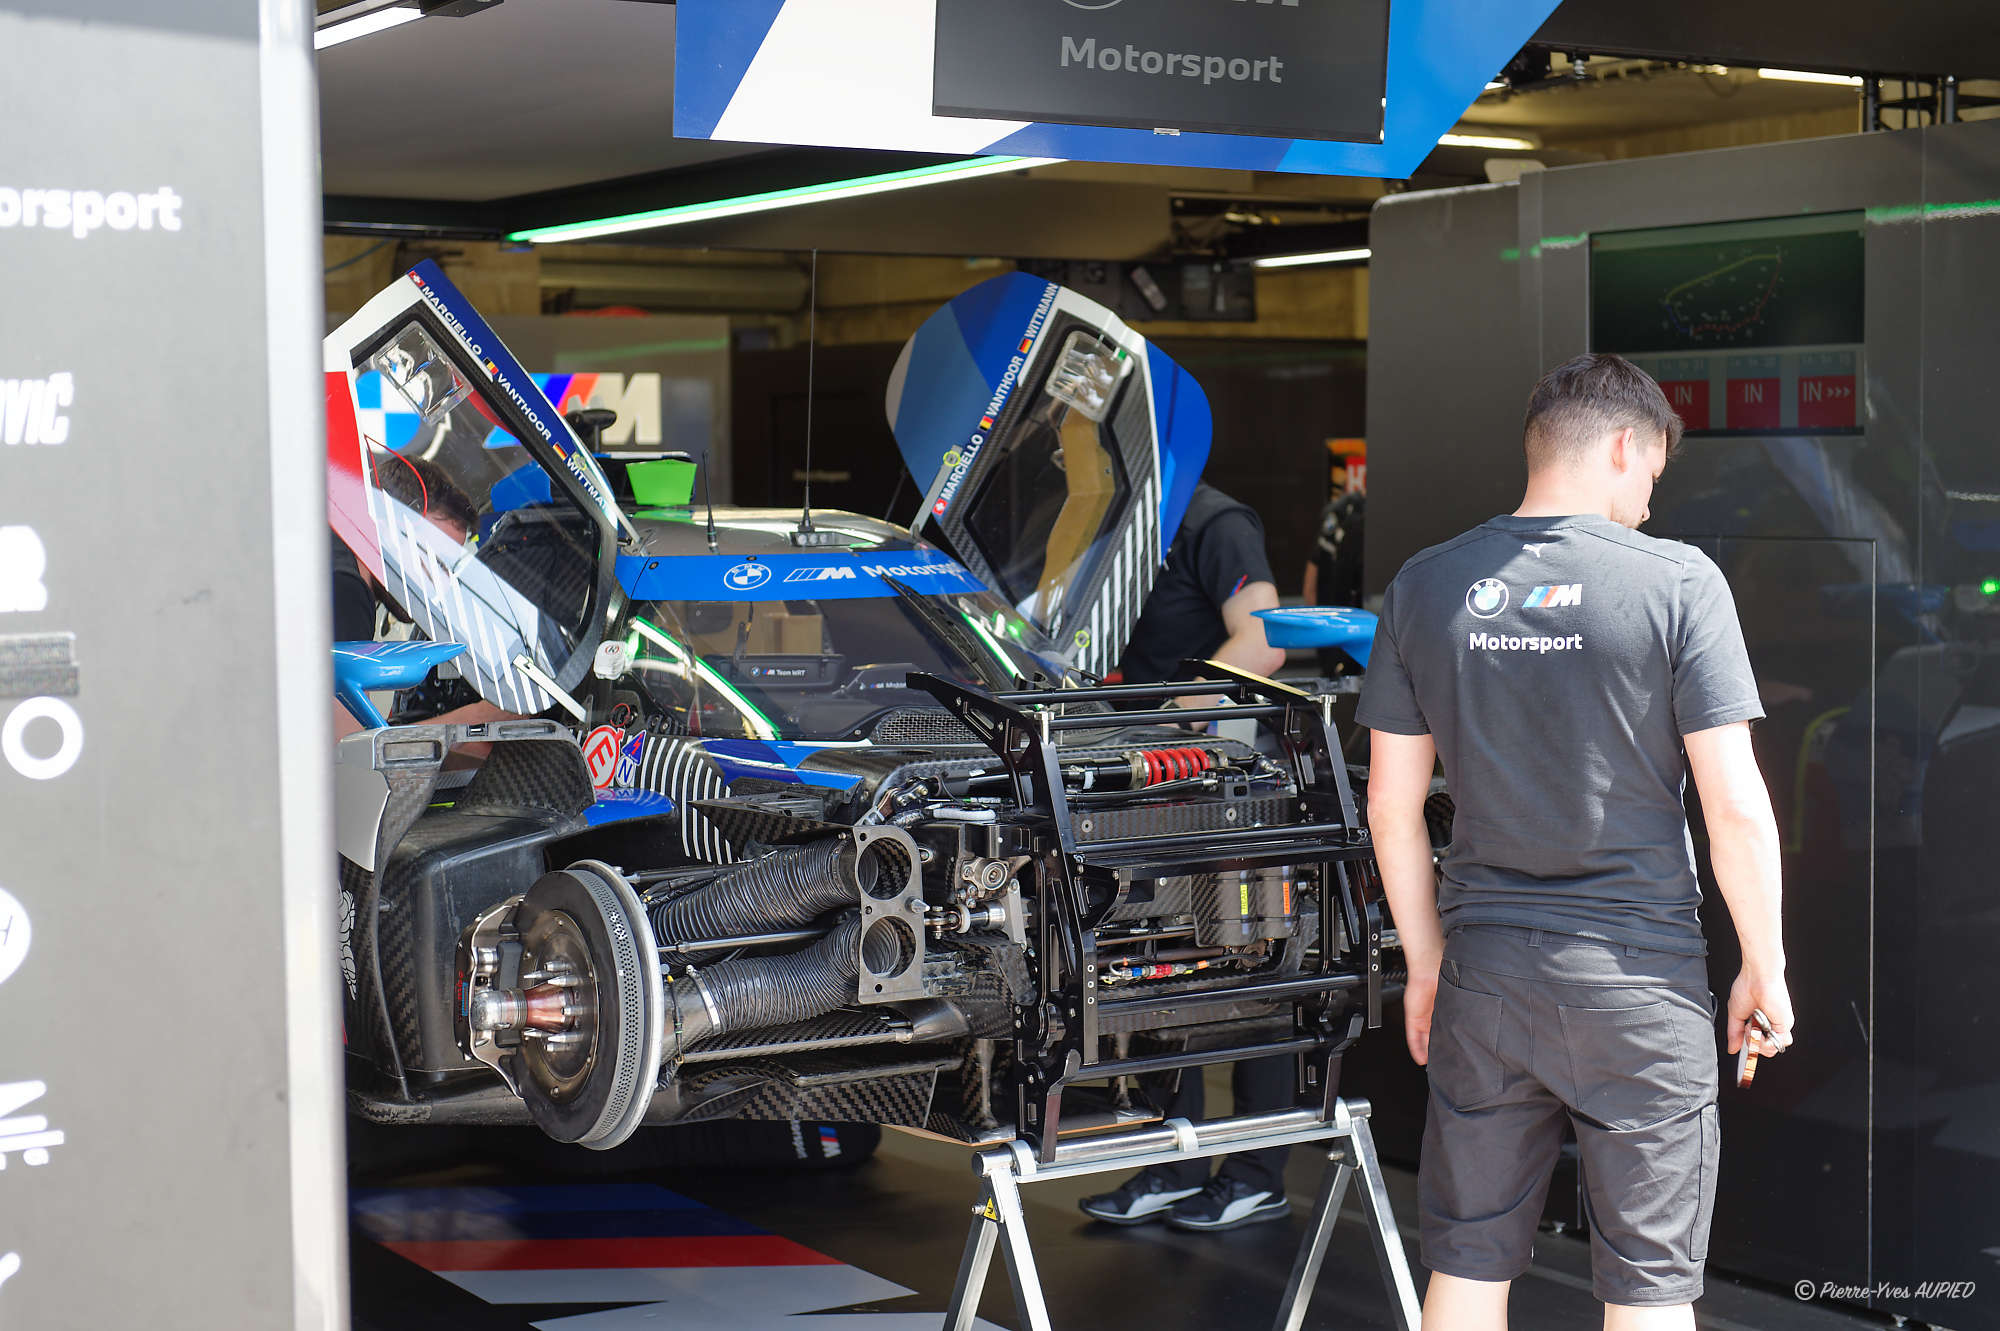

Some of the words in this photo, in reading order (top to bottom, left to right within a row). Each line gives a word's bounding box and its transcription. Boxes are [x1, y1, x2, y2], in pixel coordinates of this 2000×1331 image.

[1060, 36, 1284, 85] Motorsport
[422, 286, 482, 355] MARCIELLO
[498, 373, 551, 440] VANTHOOR
[567, 457, 607, 509] WITTMA
[940, 433, 984, 500] MARCIELLO
[985, 355, 1024, 416] VANTHOOR
[1024, 282, 1058, 338] WITTMANN
[1675, 385, 1693, 405] IN
[1745, 383, 1763, 403] IN
[1803, 381, 1823, 401] IN
[1469, 633, 1583, 654] Motorsport
[587, 735, 614, 779] E
[617, 758, 633, 783] N
